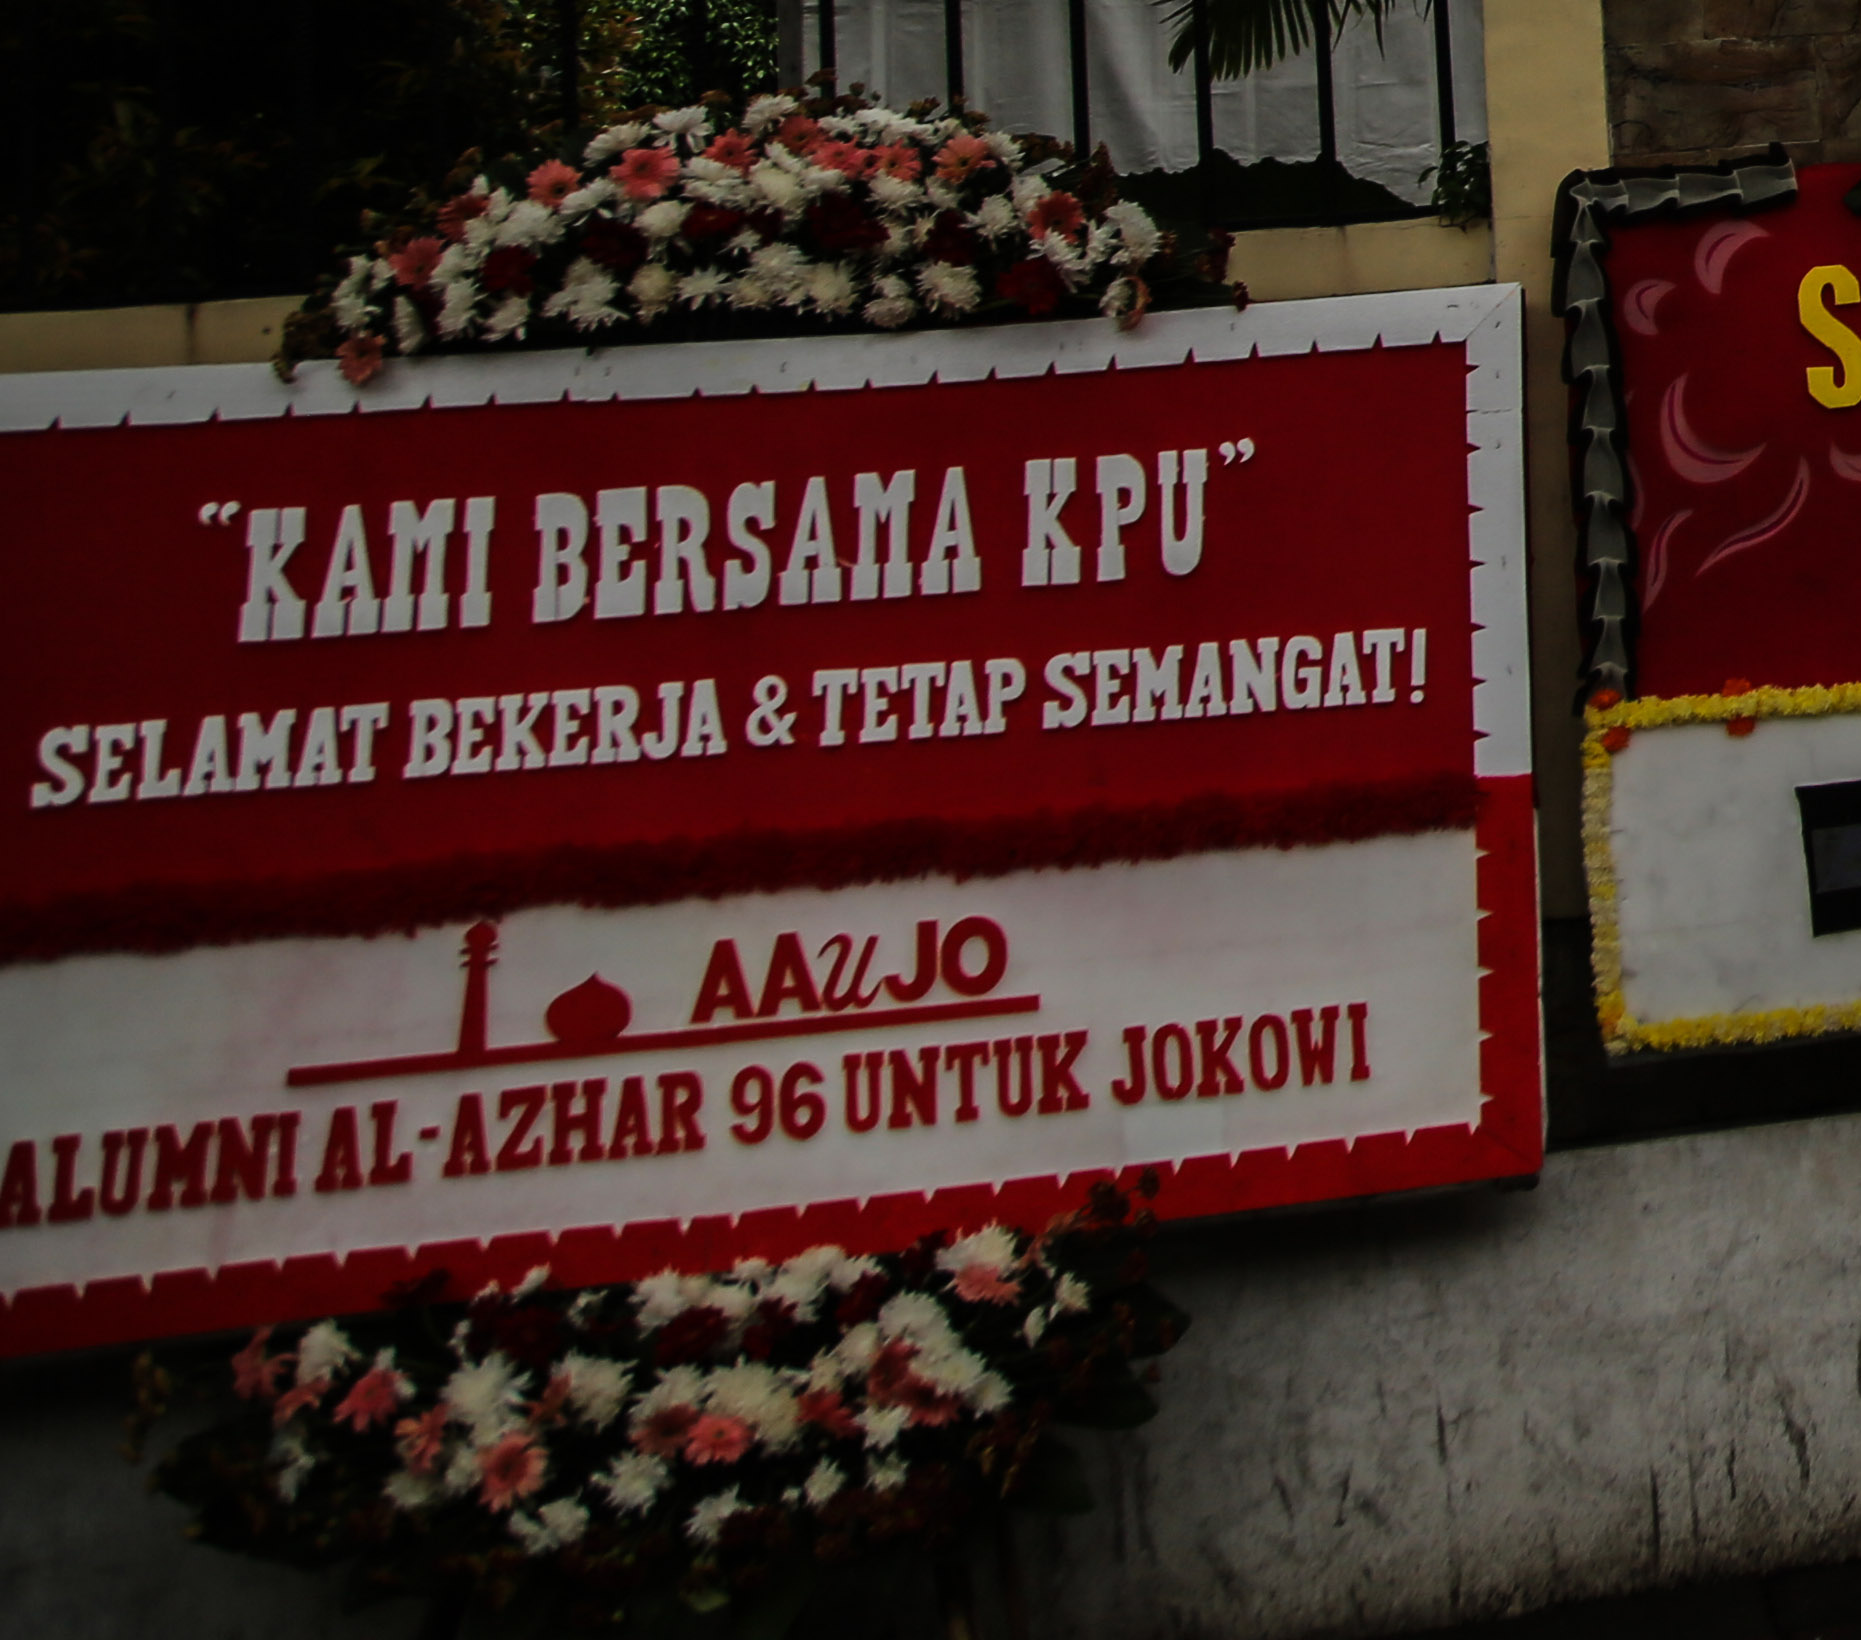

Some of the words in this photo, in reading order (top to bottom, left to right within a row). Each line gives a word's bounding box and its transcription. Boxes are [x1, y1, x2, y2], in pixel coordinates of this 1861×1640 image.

[532, 465, 983, 624] BERSAMA
[29, 702, 390, 809] SELAMAT
[404, 676, 730, 780] BEKERJA
[744, 674, 800, 747] &
[812, 655, 1028, 745] TETAP
[1040, 626, 1431, 730] SEMANGAT!
[0, 1110, 300, 1227] ALUMNI
[313, 1078, 708, 1191] AL-AZHAR
[732, 1060, 827, 1145] 96
[841, 1032, 1091, 1131] UNTUK
[1107, 1002, 1372, 1107] JOKOWI
